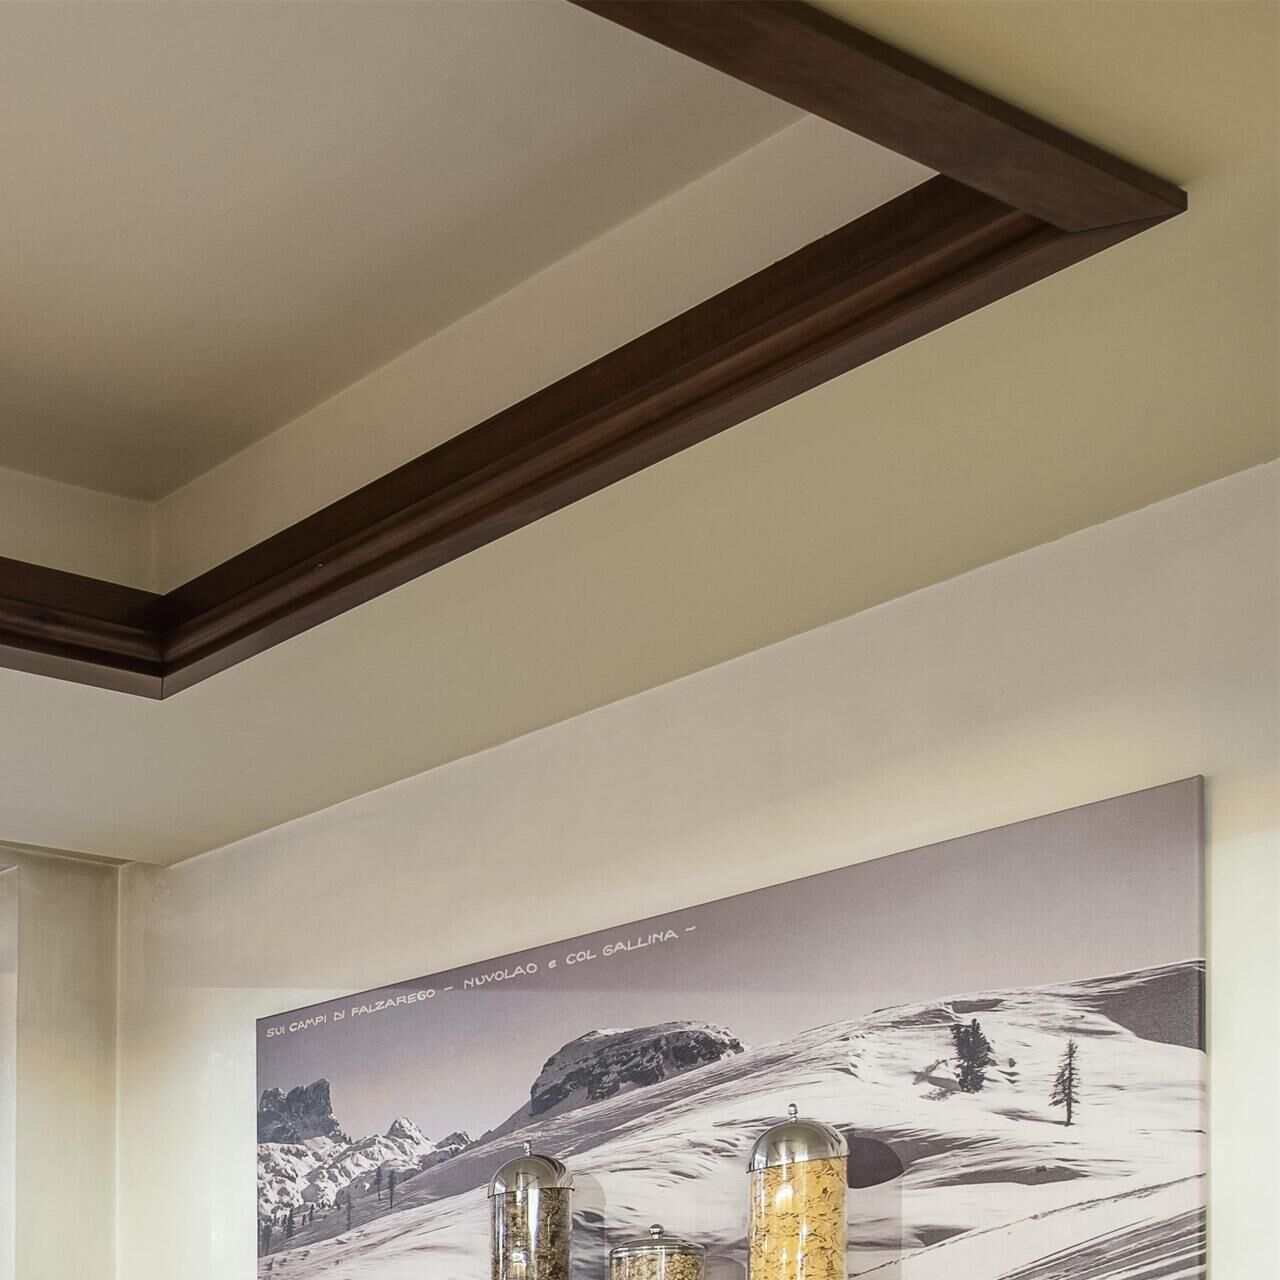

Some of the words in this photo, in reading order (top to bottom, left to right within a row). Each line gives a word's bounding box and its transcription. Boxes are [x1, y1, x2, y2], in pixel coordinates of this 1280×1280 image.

[266, 1027, 285, 1038] SUI
[289, 1016, 327, 1033] CAMPI
[351, 989, 435, 1017] FALZAREGO
[464, 962, 538, 989] NUVOLAO
[566, 950, 597, 965] COL
[602, 929, 679, 956] GALLINA
